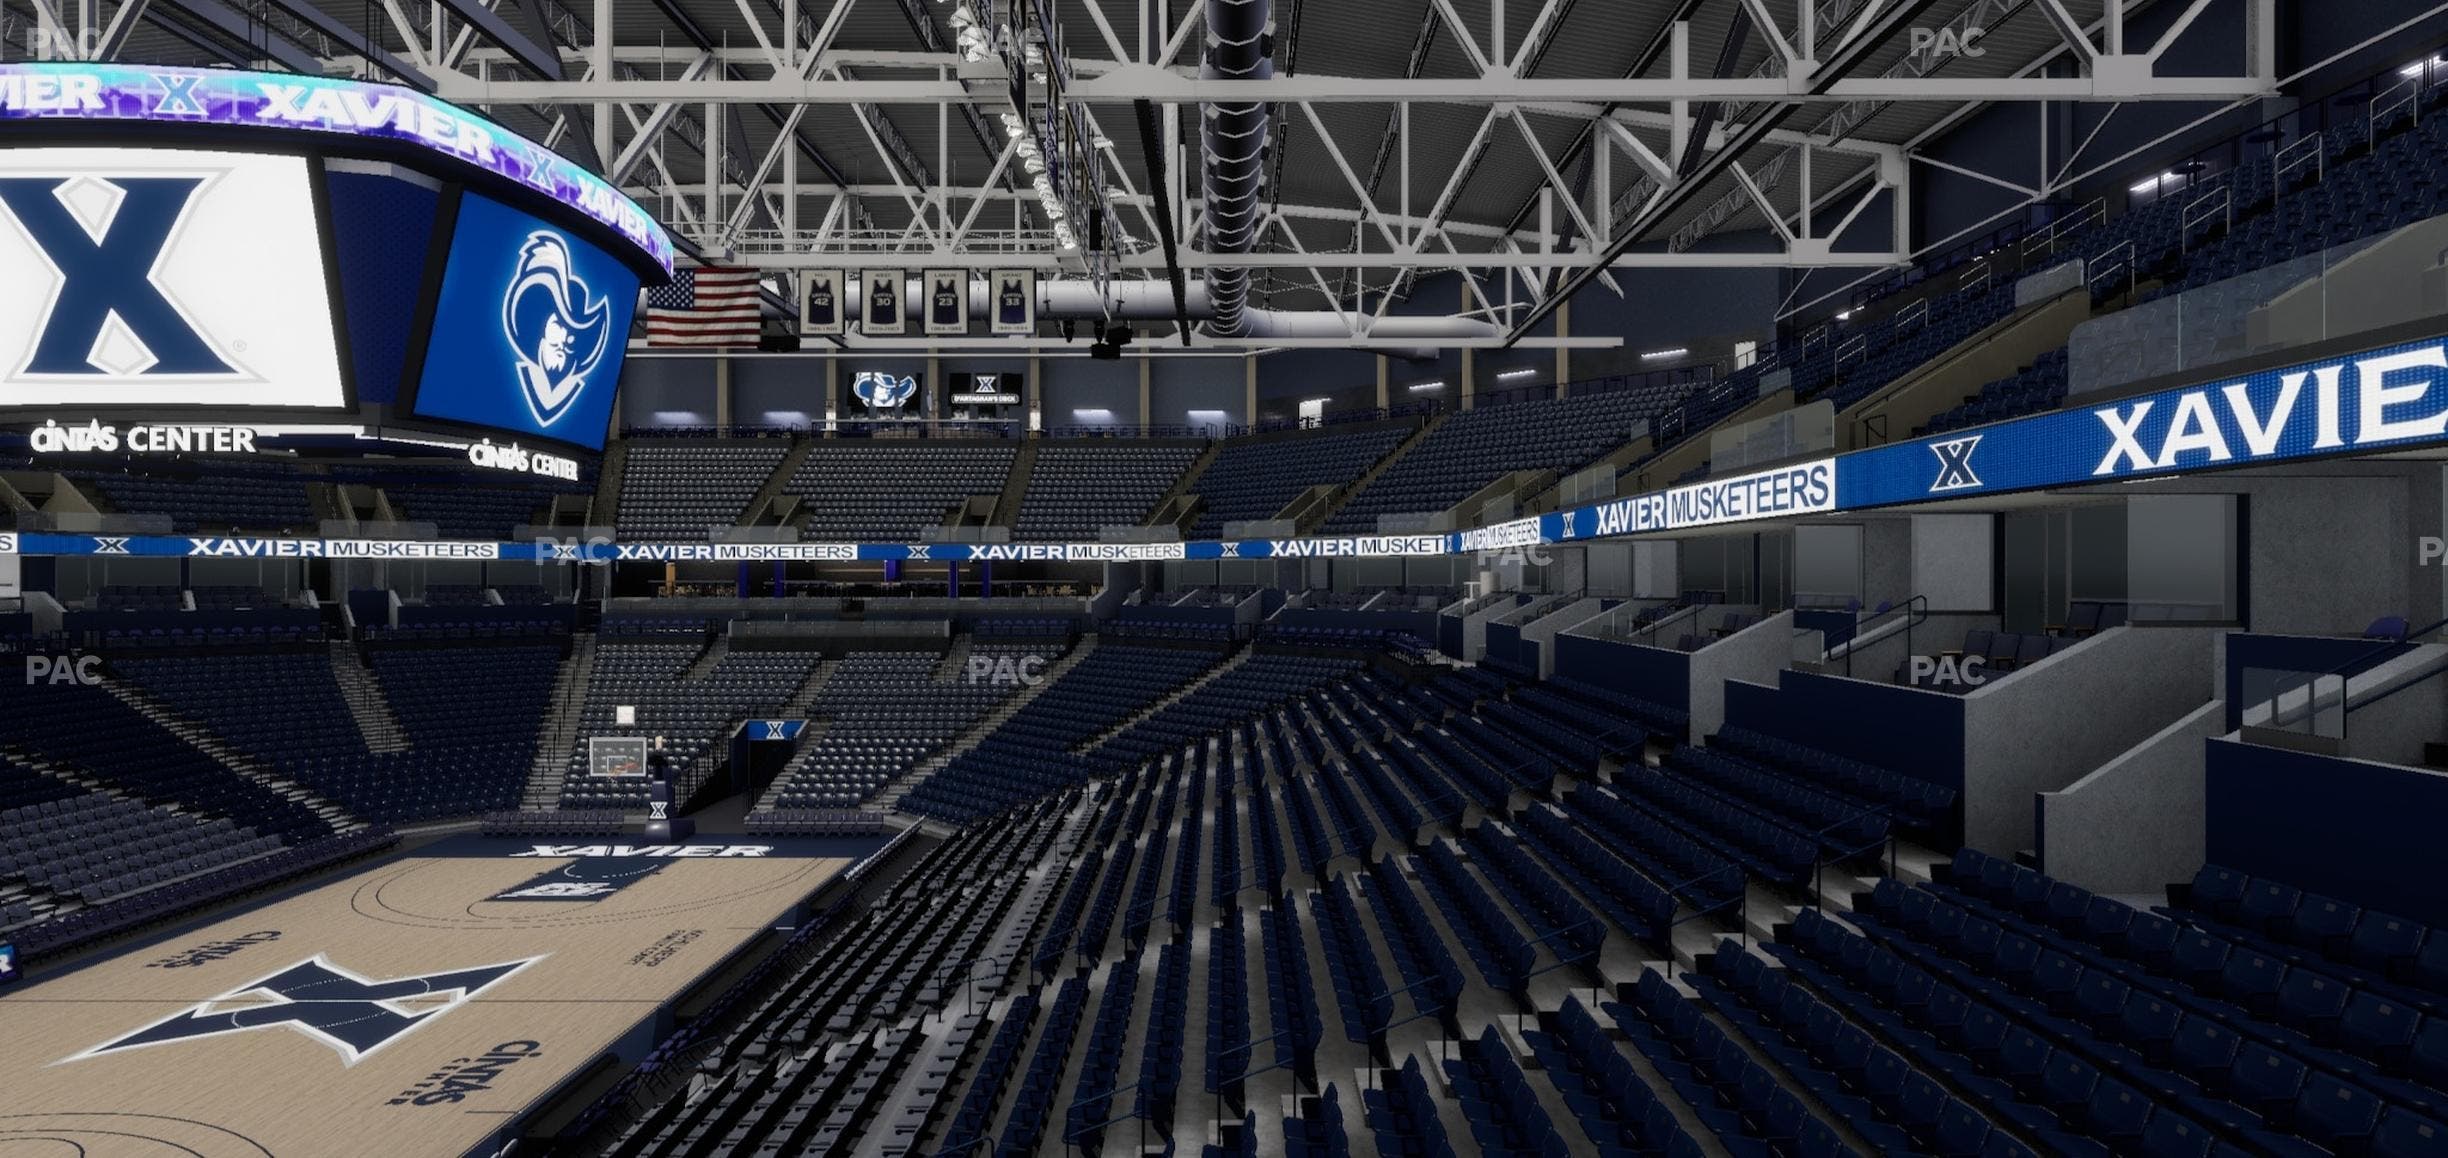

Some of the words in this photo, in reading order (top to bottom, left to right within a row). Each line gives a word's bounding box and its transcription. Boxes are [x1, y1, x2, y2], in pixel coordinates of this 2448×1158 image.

[151, 74, 209, 115] X
[256, 83, 496, 163] XAVIER
[526, 147, 557, 193] X
[575, 174, 649, 247] XAVIER
[0, 167, 270, 383] X
[814, 298, 829, 306] 42
[876, 298, 891, 306] 30
[975, 376, 997, 393] X
[127, 426, 256, 453] CENTER
[532, 453, 578, 481] CENTER
[1929, 433, 1984, 493] X
[1595, 493, 1666, 536] XAVIER
[1671, 464, 1829, 522] MUSKETEERS
[1562, 512, 1575, 537] X
[93, 536, 130, 554] X
[1460, 527, 1487, 551] XAVIER
[1488, 519, 1539, 549] MUSKETEERS
[188, 538, 323, 557] XAVIER
[333, 541, 494, 558] MUSKETEERS
[617, 544, 713, 560] XAVIER
[720, 545, 854, 559] MUSKETEERS
[906, 544, 931, 560] X
[968, 544, 1064, 560] XAVIER
[1072, 544, 1182, 559] MUSKETEERS
[1221, 542, 1240, 557] X
[1270, 539, 1354, 557] XAVIER
[1361, 537, 1442, 554] MUSKET
[766, 721, 785, 740] X
[650, 801, 668, 820] X
[509, 845, 775, 857] XAVIER
